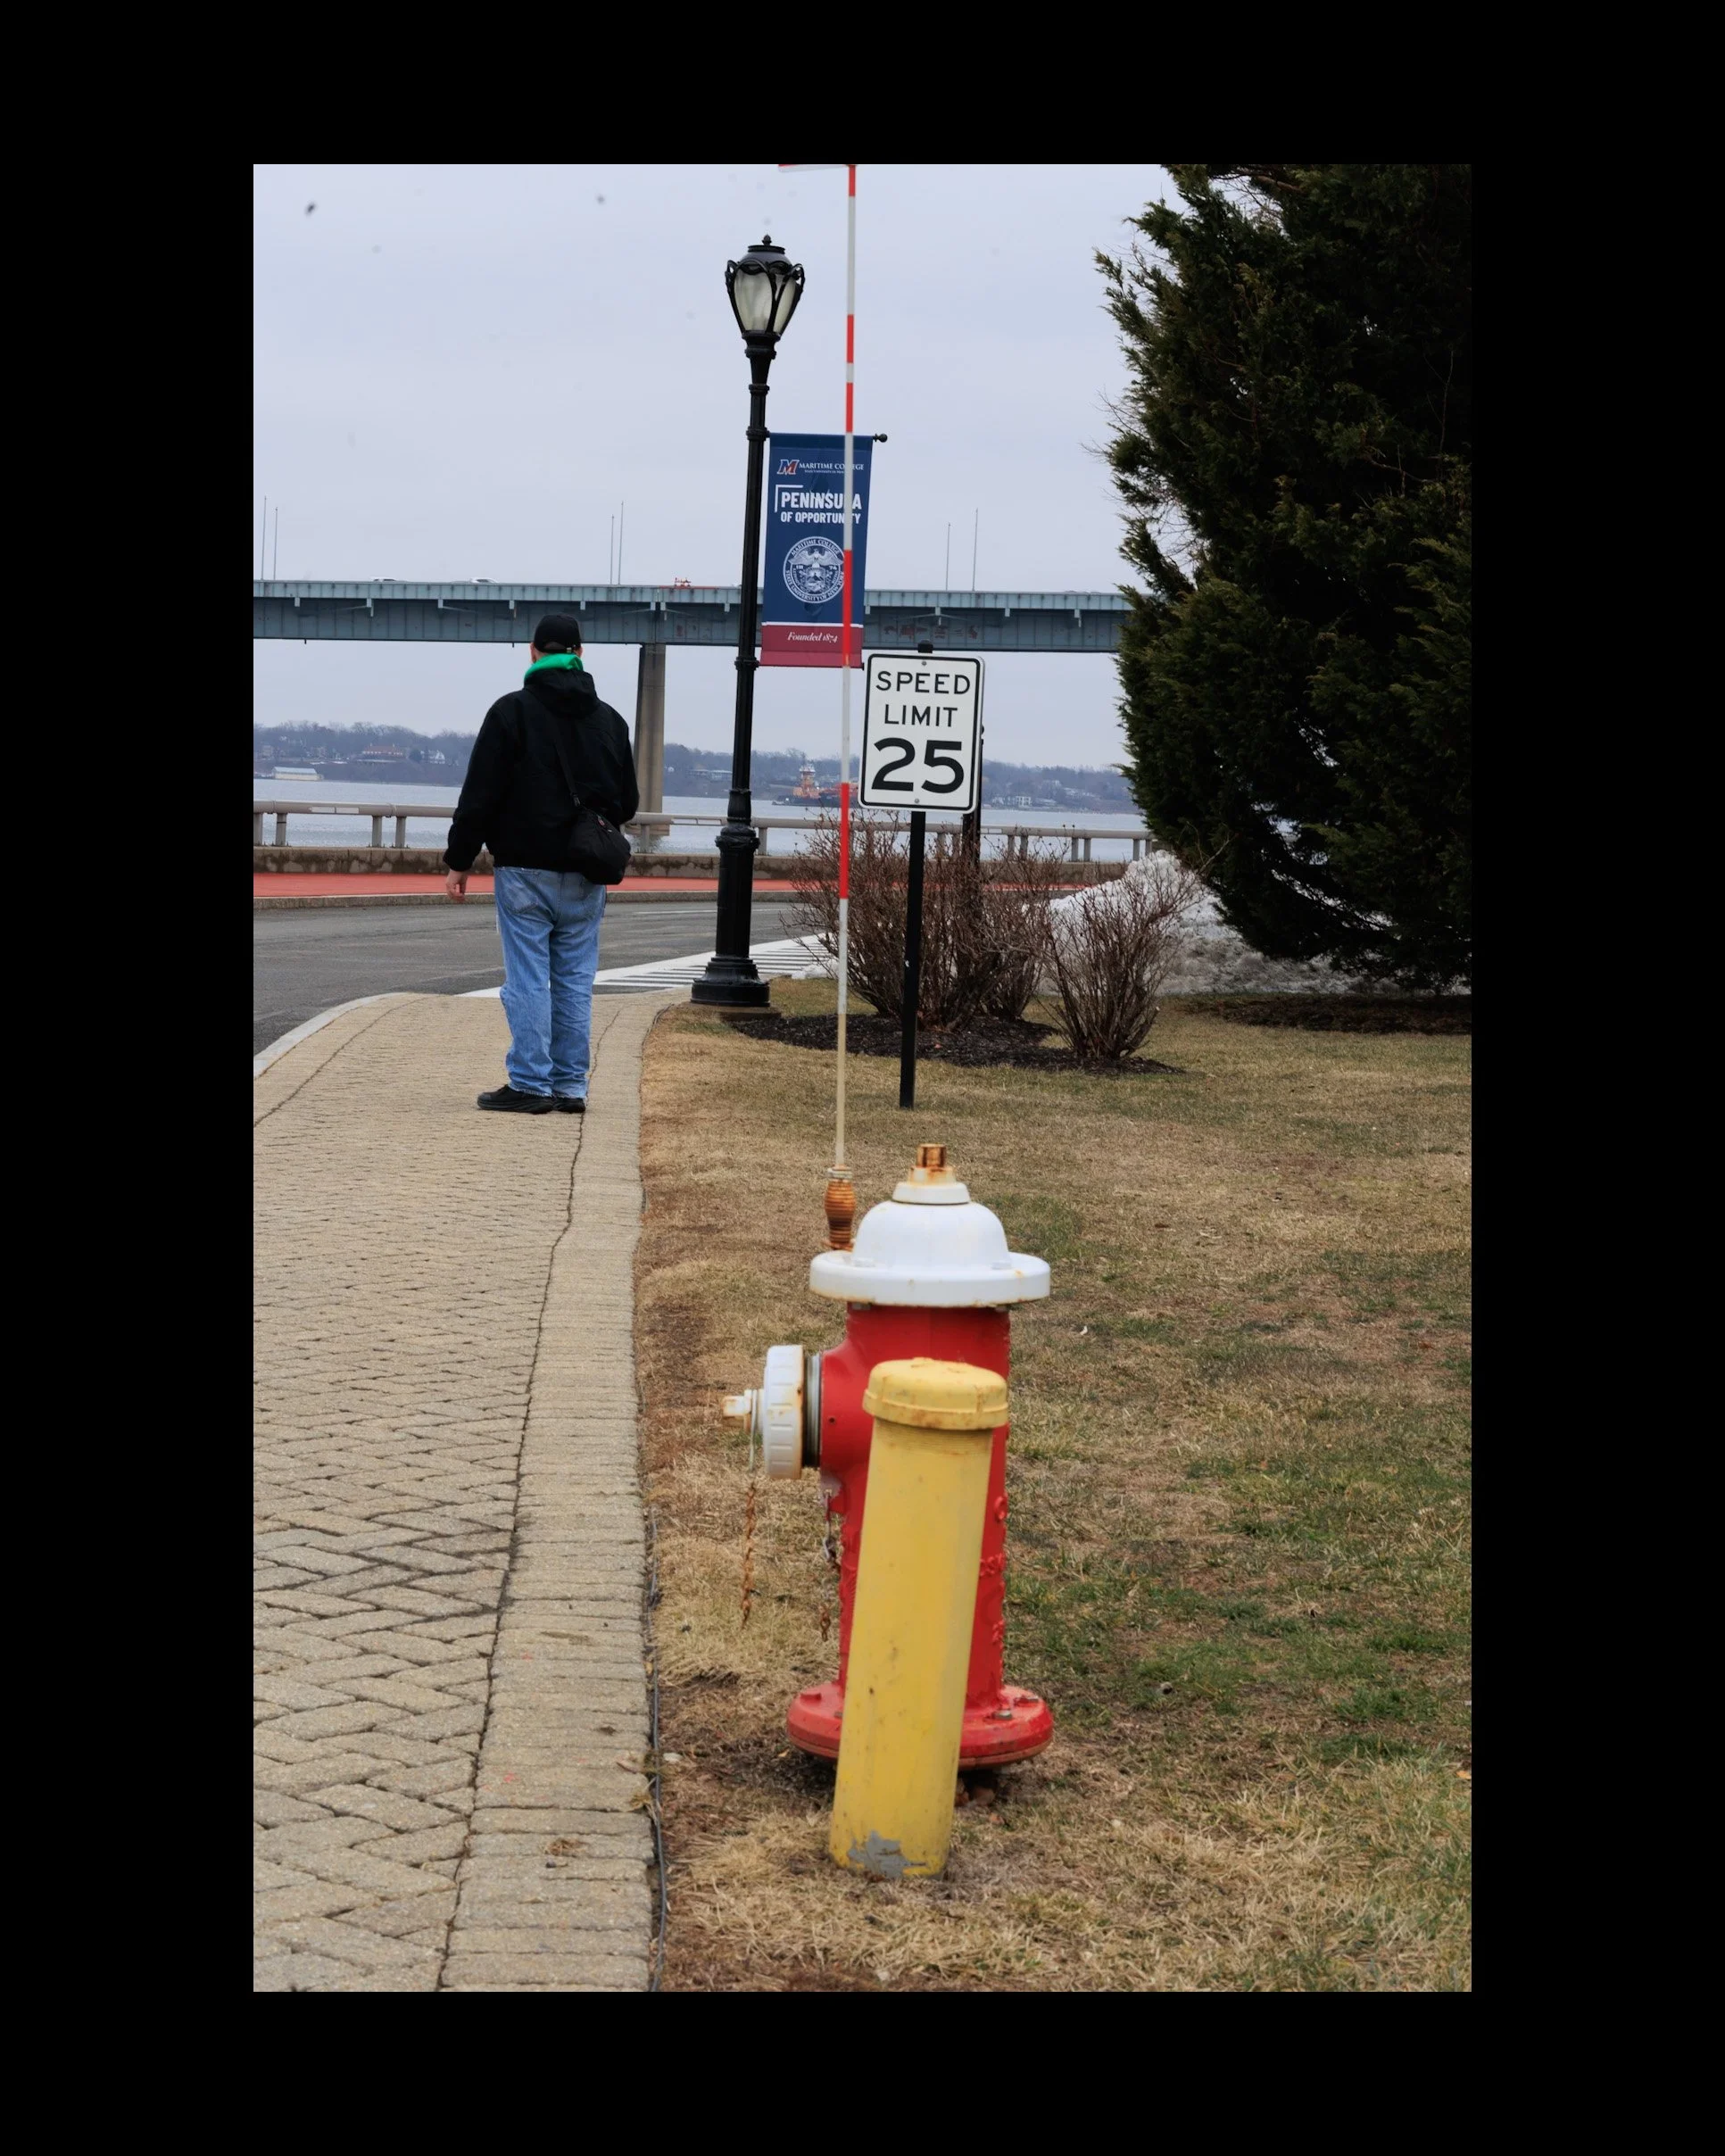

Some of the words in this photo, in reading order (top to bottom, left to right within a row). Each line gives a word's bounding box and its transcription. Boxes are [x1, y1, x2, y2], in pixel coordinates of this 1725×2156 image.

[776, 459, 800, 475] M
[781, 492, 862, 510] PENINSUA
[780, 511, 793, 523] OF
[795, 511, 861, 524] OPPORTUNY
[791, 539, 816, 556] MARITIME
[787, 631, 822, 642] Founded
[823, 633, 838, 643] 1874
[875, 670, 971, 695] SPEED
[884, 703, 958, 727] LIMIT
[871, 737, 965, 793] 25
